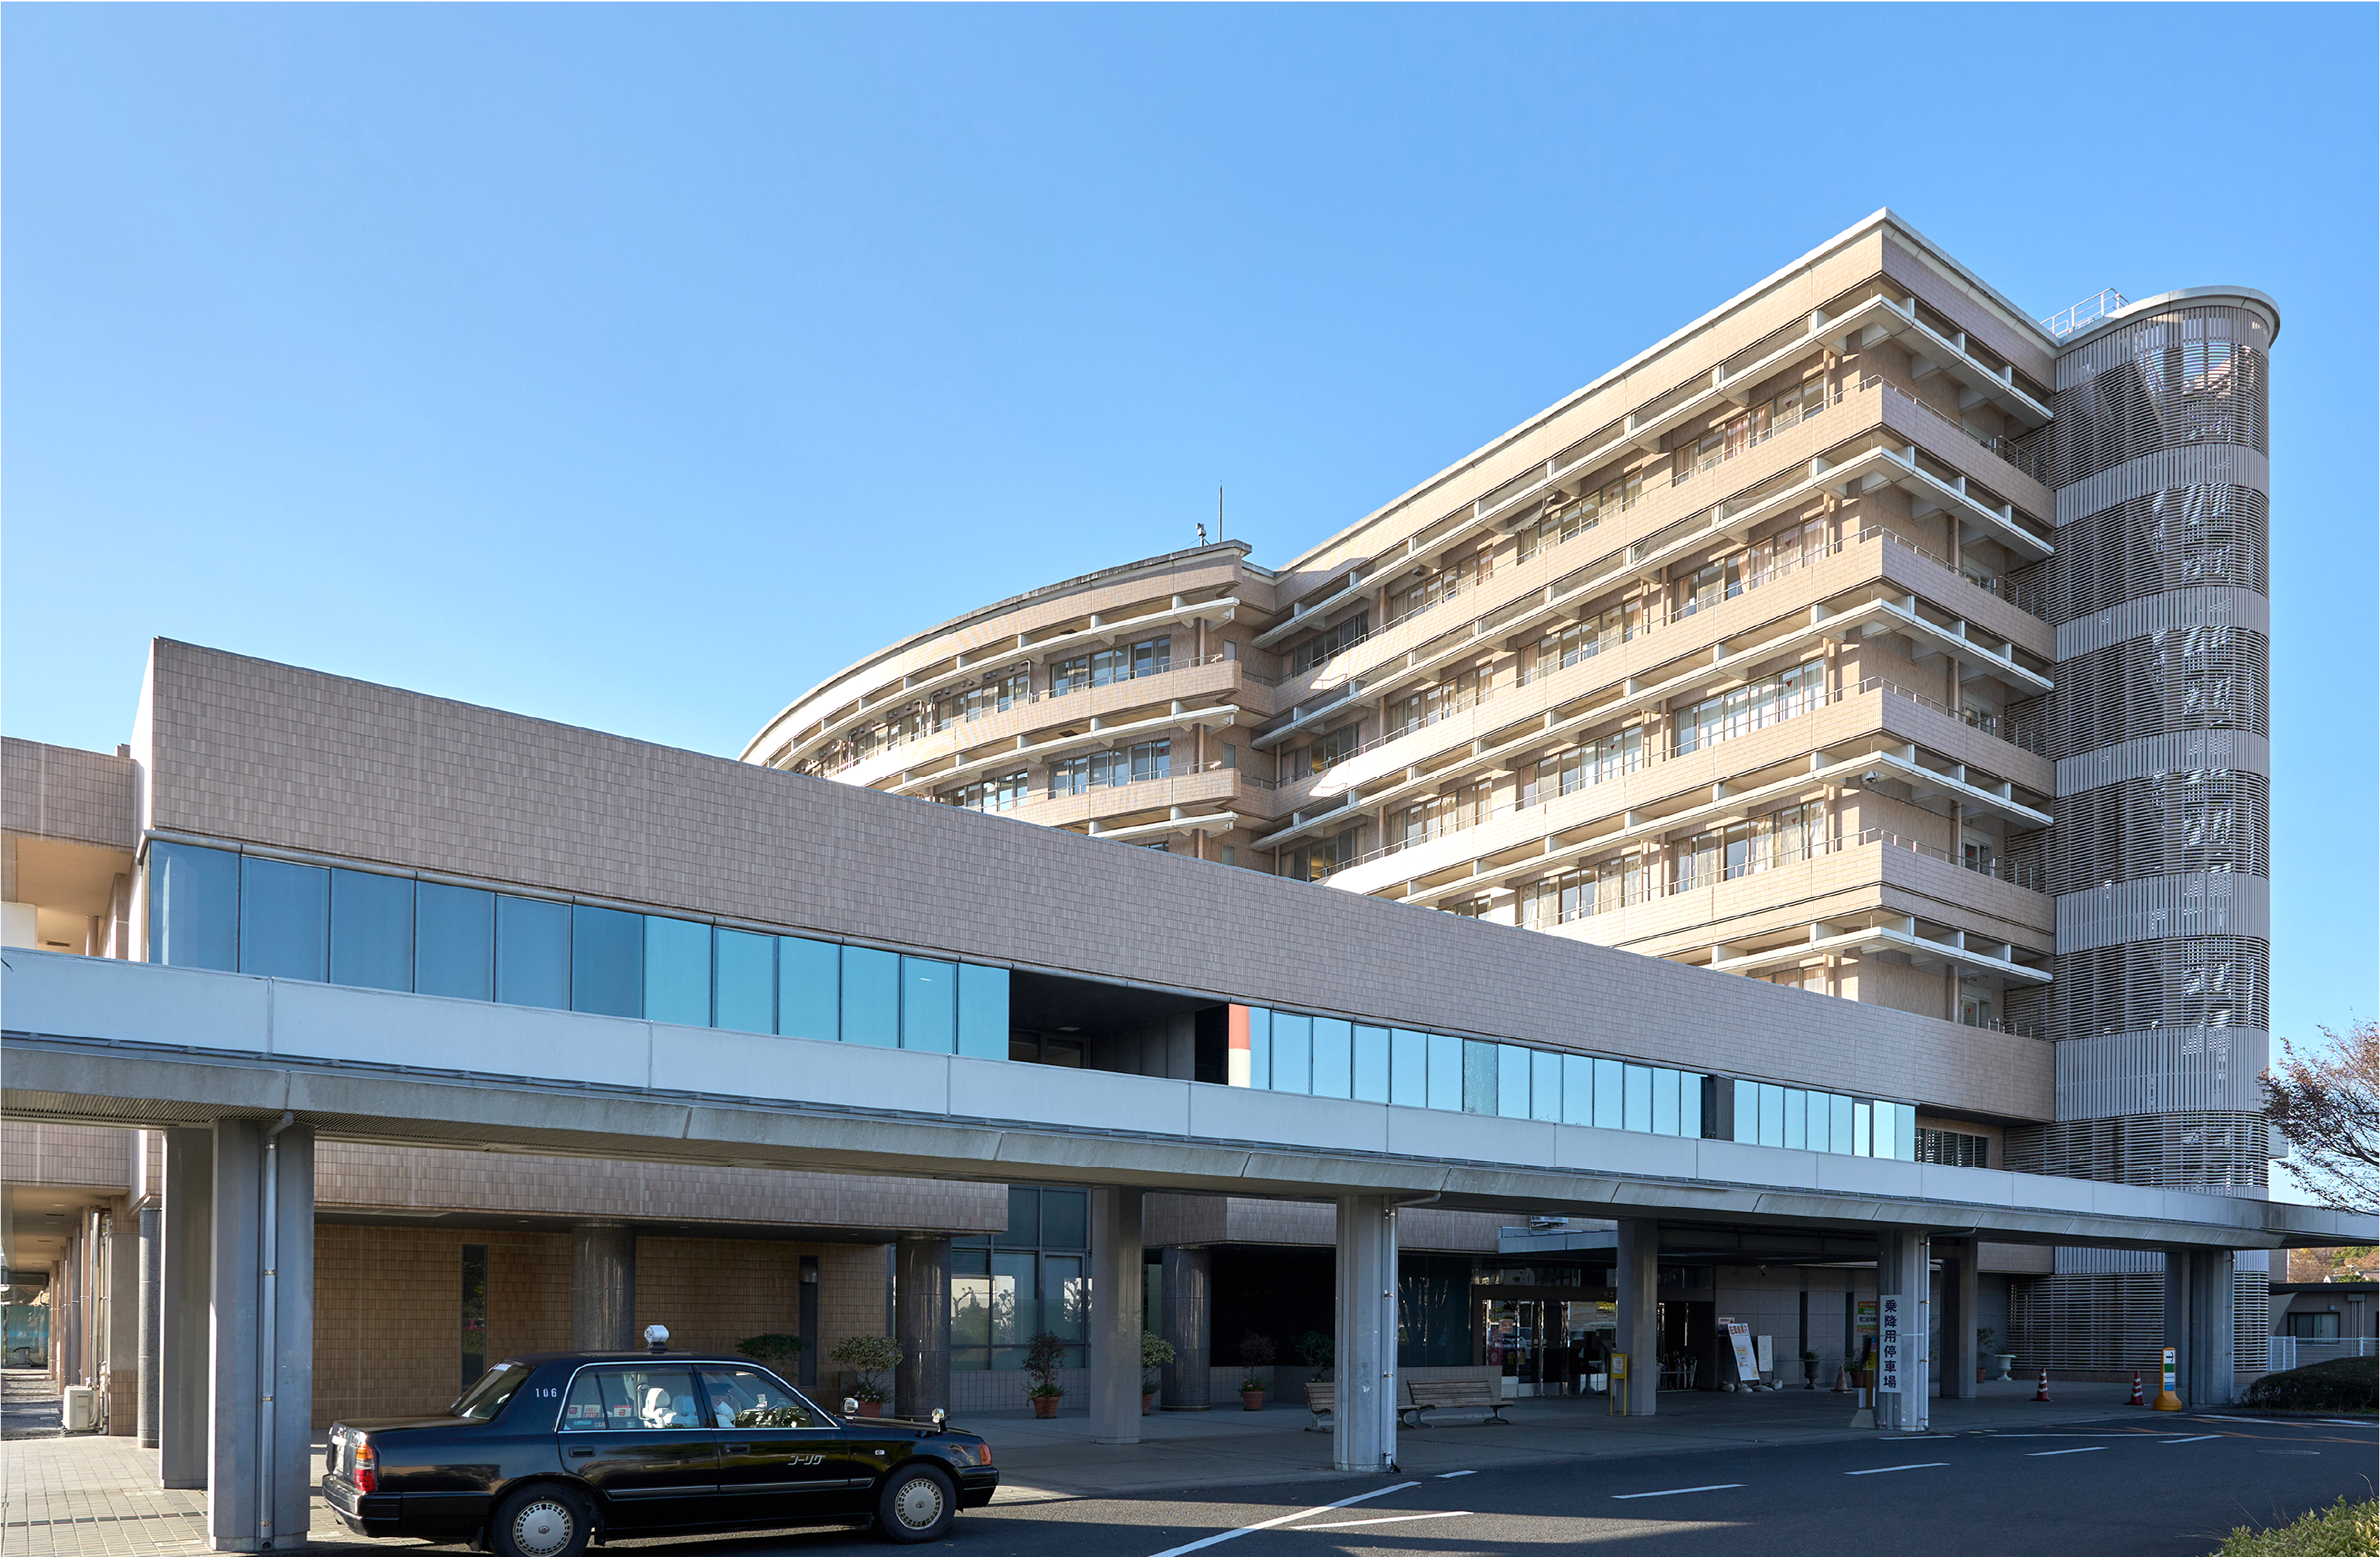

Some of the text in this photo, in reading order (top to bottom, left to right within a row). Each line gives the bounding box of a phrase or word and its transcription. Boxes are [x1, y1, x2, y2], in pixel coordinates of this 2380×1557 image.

[1883, 1299, 1897, 1388] 乗降用停車場
[535, 1388, 557, 1398] 106
